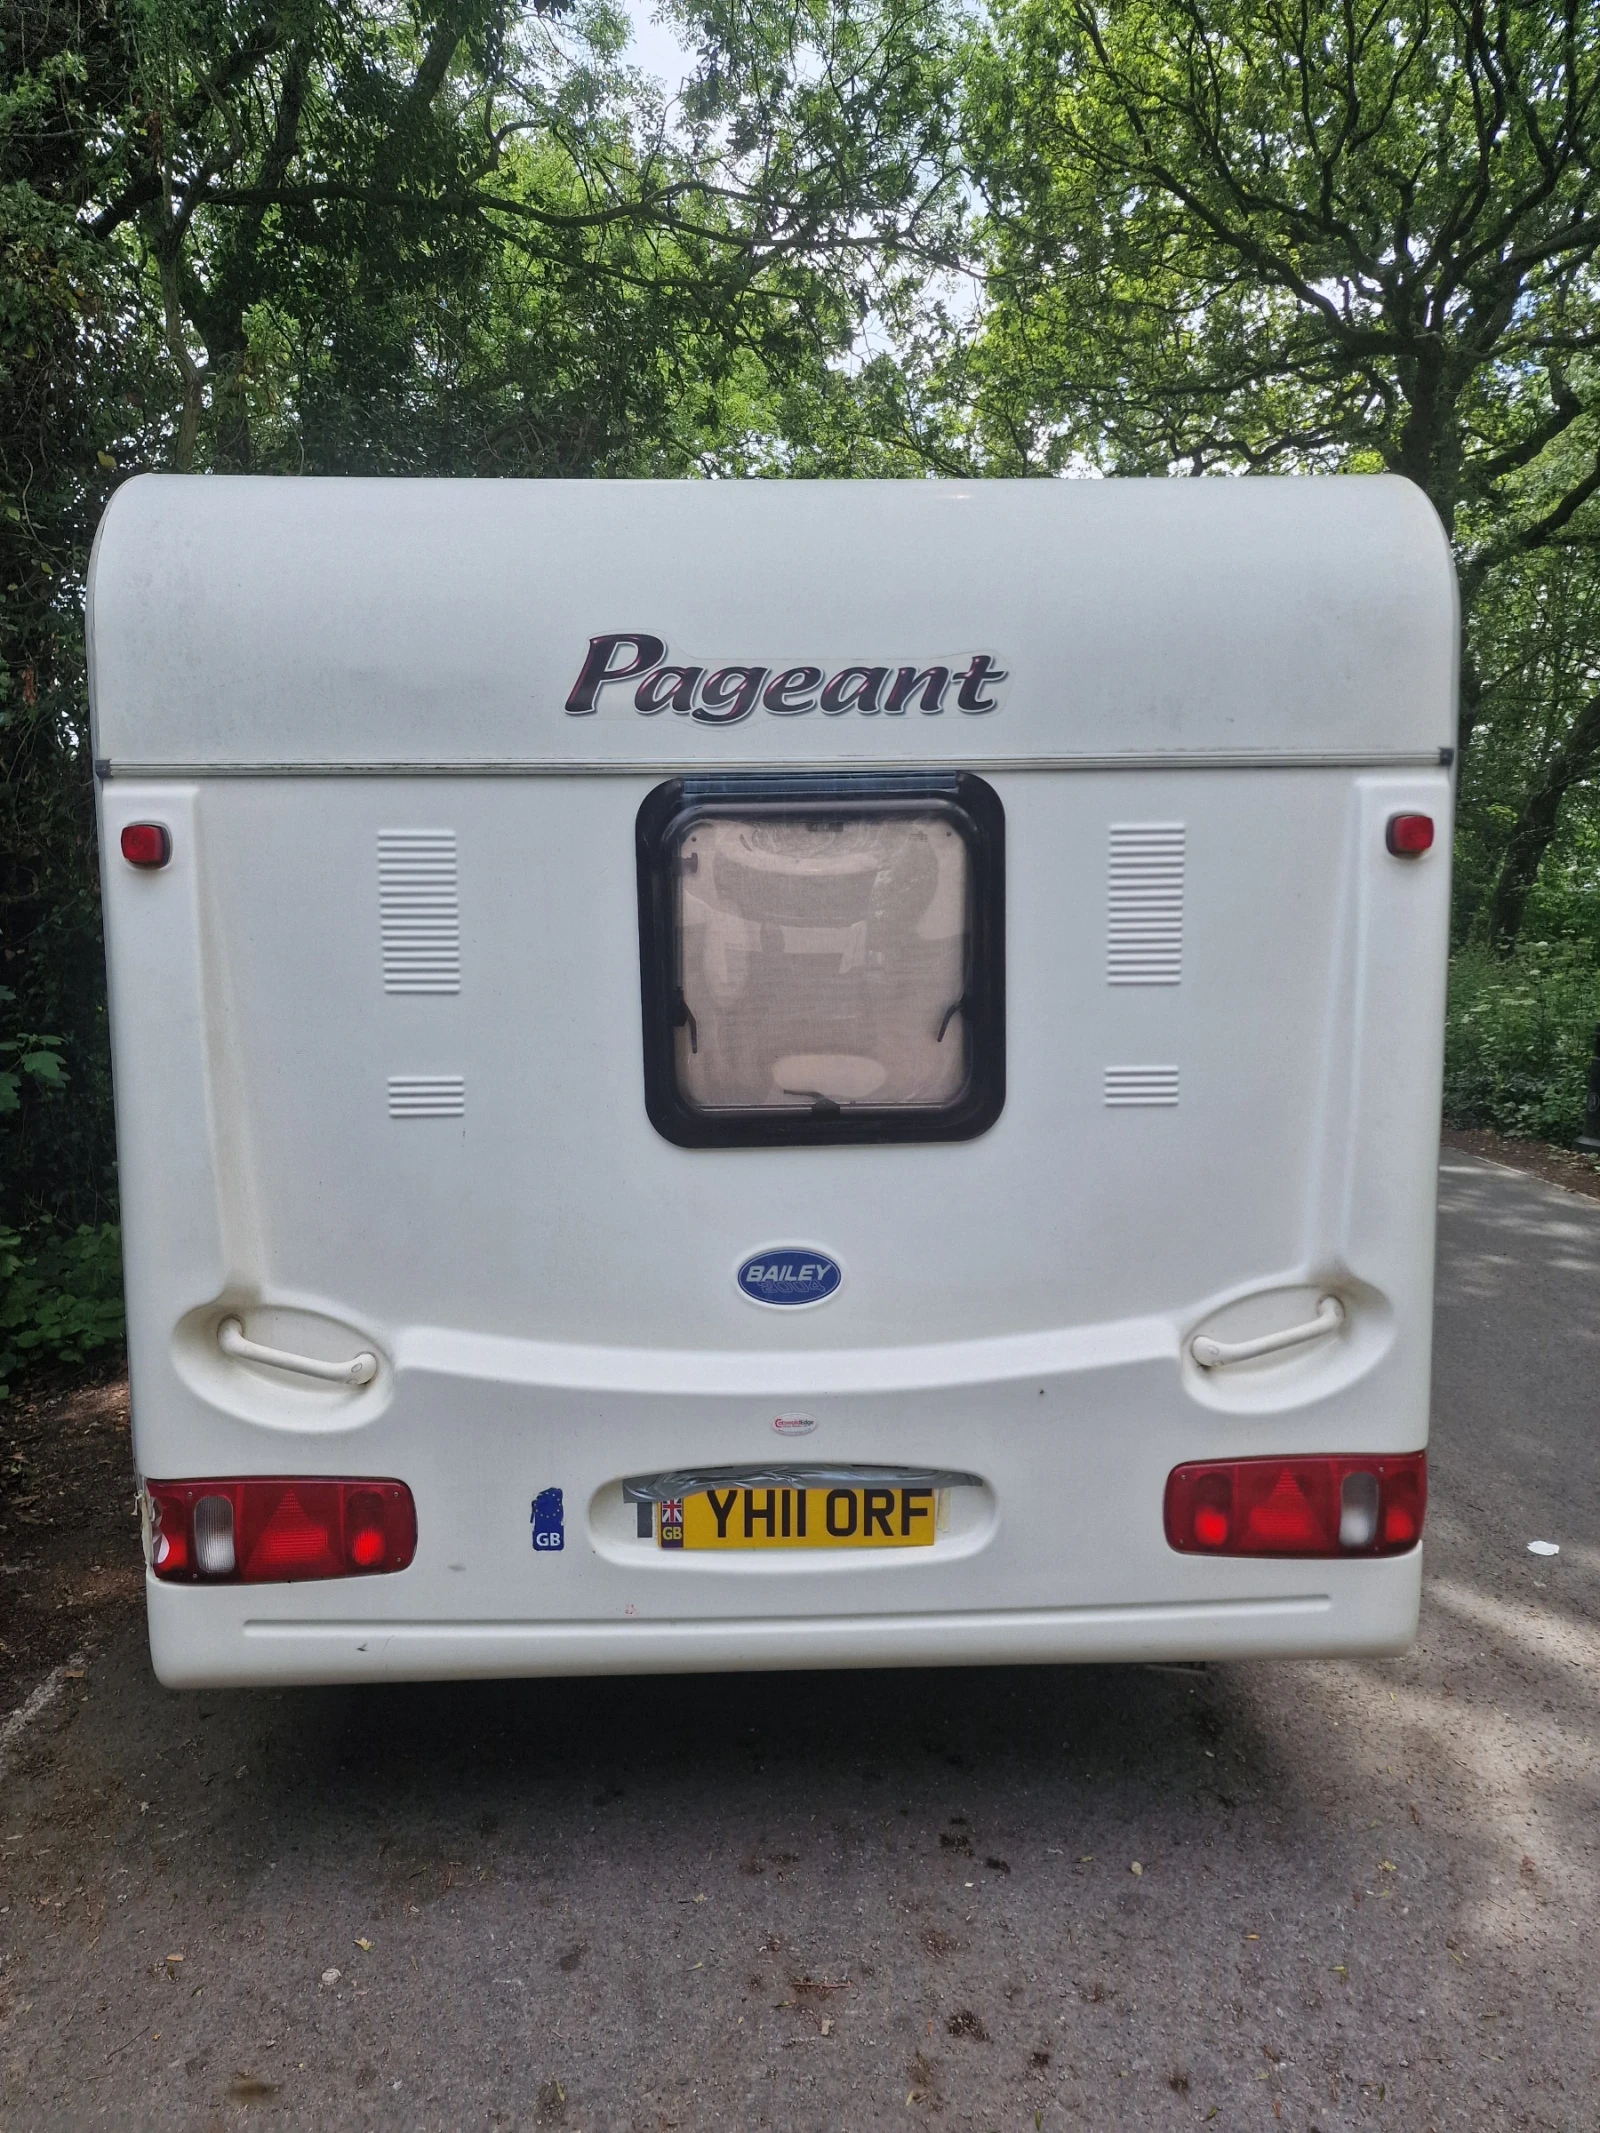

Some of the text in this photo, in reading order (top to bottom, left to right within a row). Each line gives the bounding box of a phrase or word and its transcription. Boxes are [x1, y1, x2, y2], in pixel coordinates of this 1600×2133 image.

[564, 632, 1008, 725] Pageant
[745, 1264, 832, 1282] BAILEY
[757, 1280, 826, 1293] 2004
[826, 1488, 932, 1536] ORF
[536, 1532, 561, 1546] GB
[662, 1526, 683, 1540] GB
